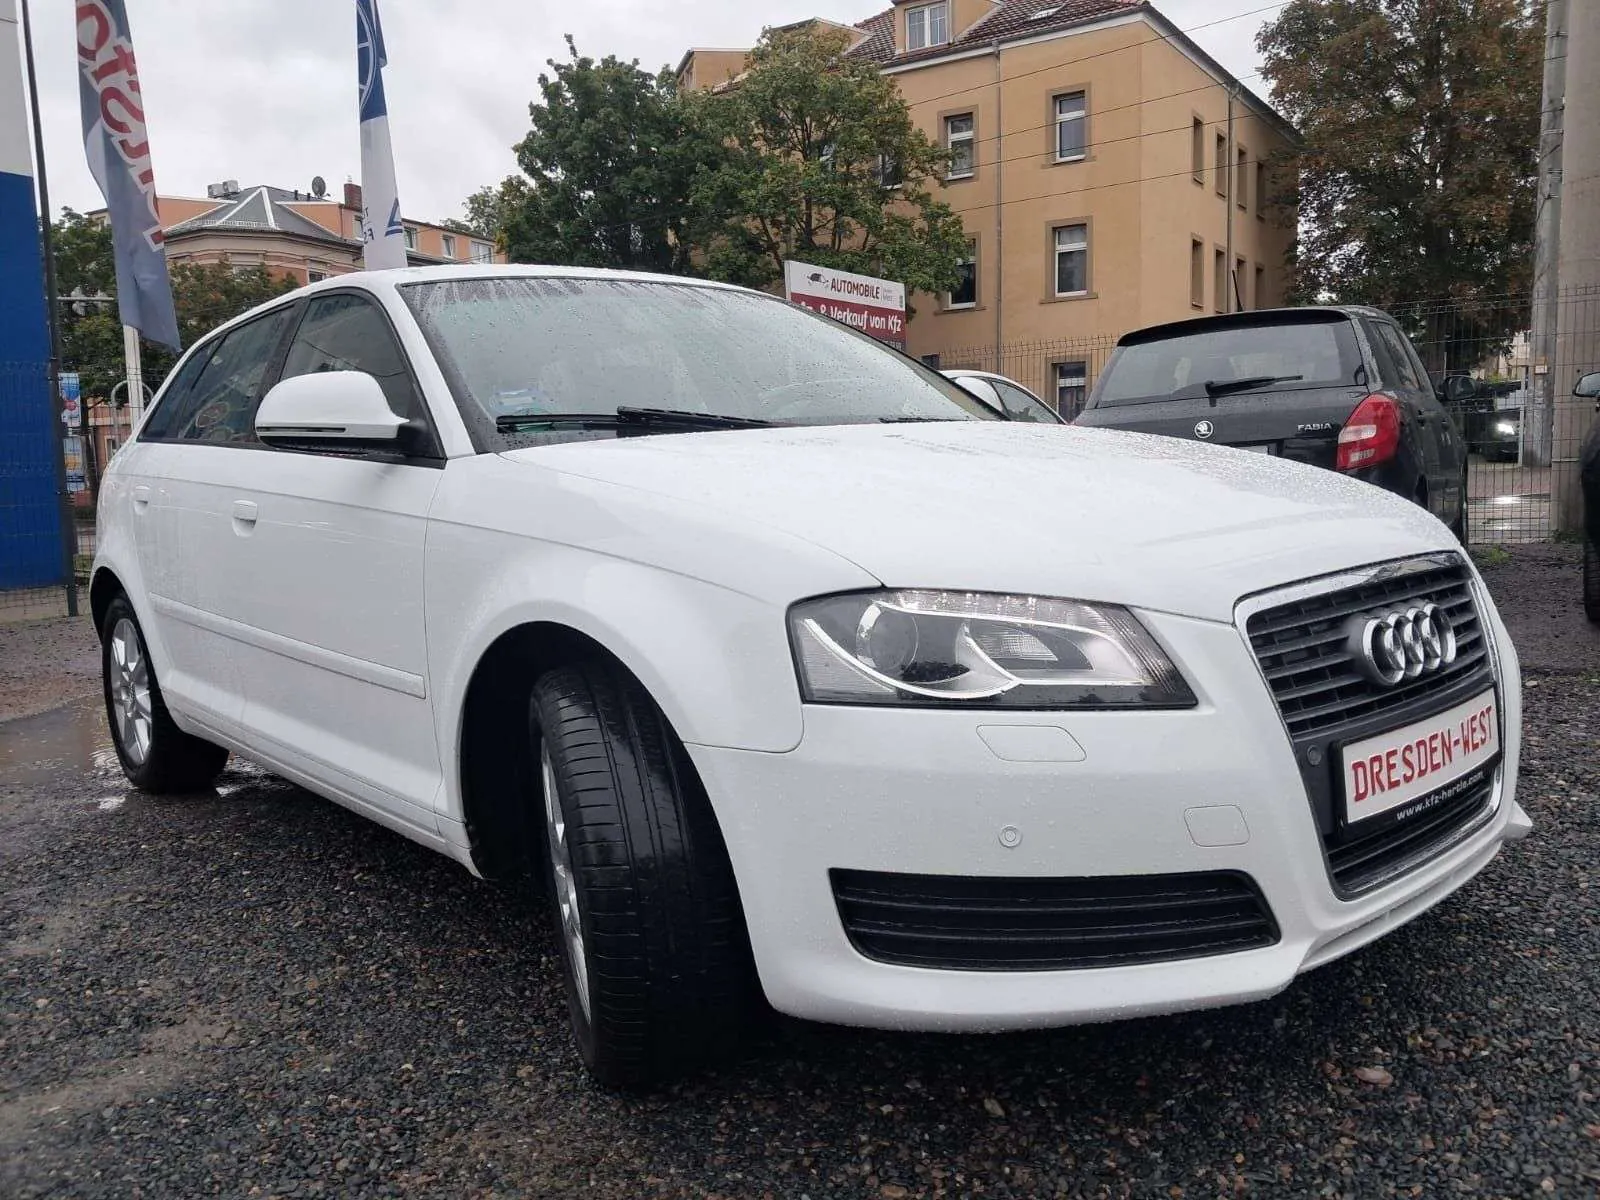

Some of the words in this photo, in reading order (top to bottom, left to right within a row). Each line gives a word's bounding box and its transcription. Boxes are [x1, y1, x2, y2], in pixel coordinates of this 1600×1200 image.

[830, 277, 880, 300] AUTOMOBILE
[830, 305, 868, 329] Verkauf
[869, 315, 886, 329] von
[887, 315, 901, 334] Kfz
[1297, 422, 1332, 432] FABIA
[1351, 705, 1492, 803] DRESDEN-WEST
